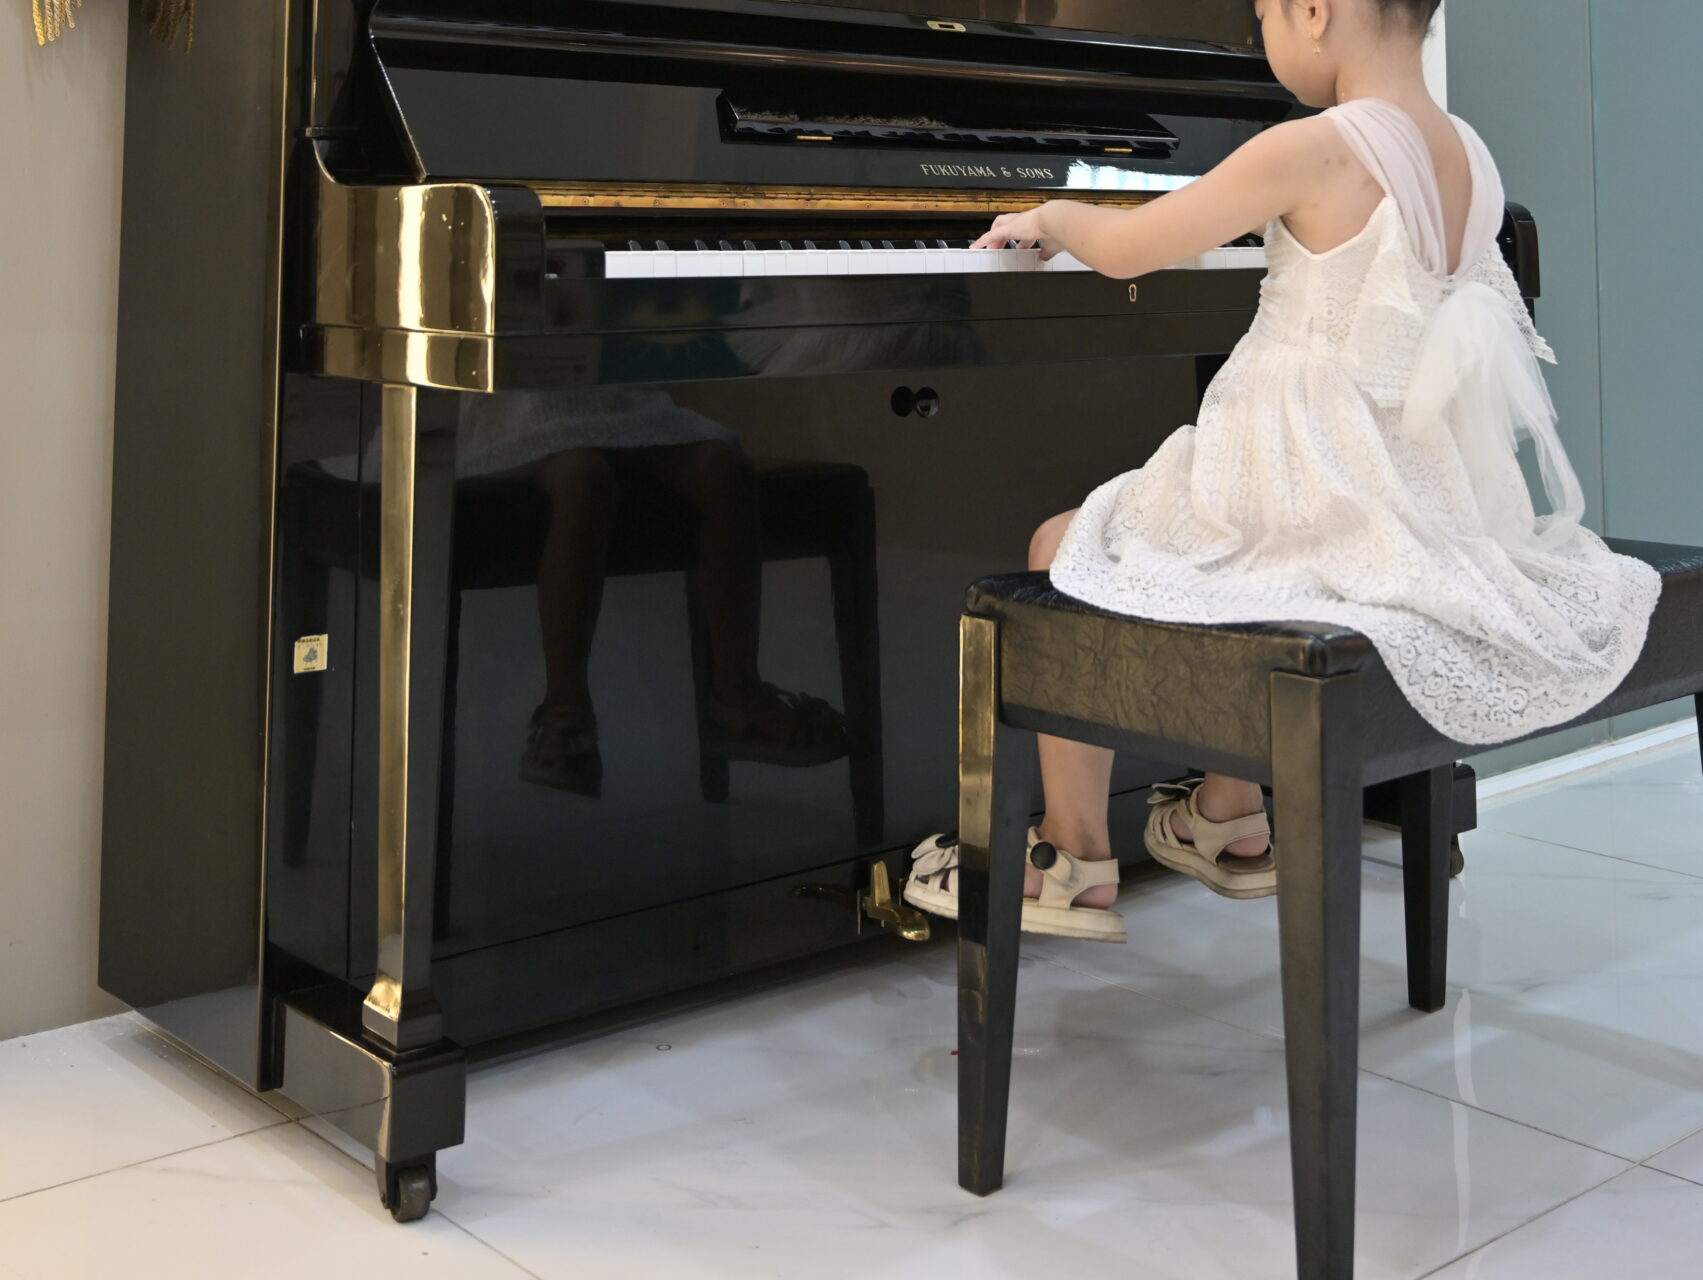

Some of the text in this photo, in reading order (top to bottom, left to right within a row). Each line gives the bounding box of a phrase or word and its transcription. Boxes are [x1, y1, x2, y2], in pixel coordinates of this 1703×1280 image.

[920, 164, 1054, 179] FUKUYAMA & SONS
